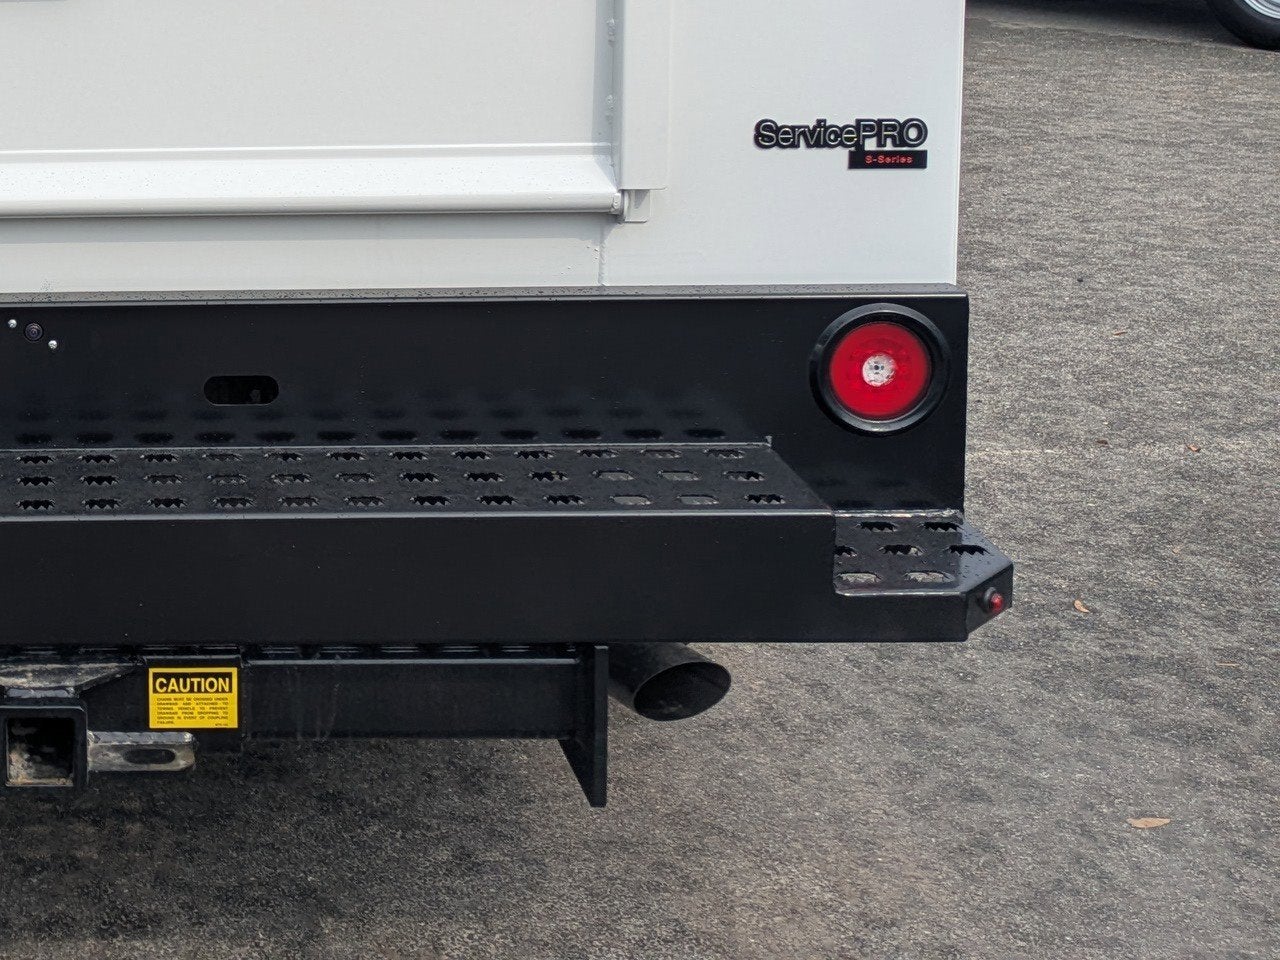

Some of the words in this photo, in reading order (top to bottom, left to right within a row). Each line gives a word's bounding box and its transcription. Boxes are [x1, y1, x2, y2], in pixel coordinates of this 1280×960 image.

[754, 118, 928, 149] ServicePRO
[865, 154, 913, 164] S-Series
[155, 678, 230, 692] CAUTION
